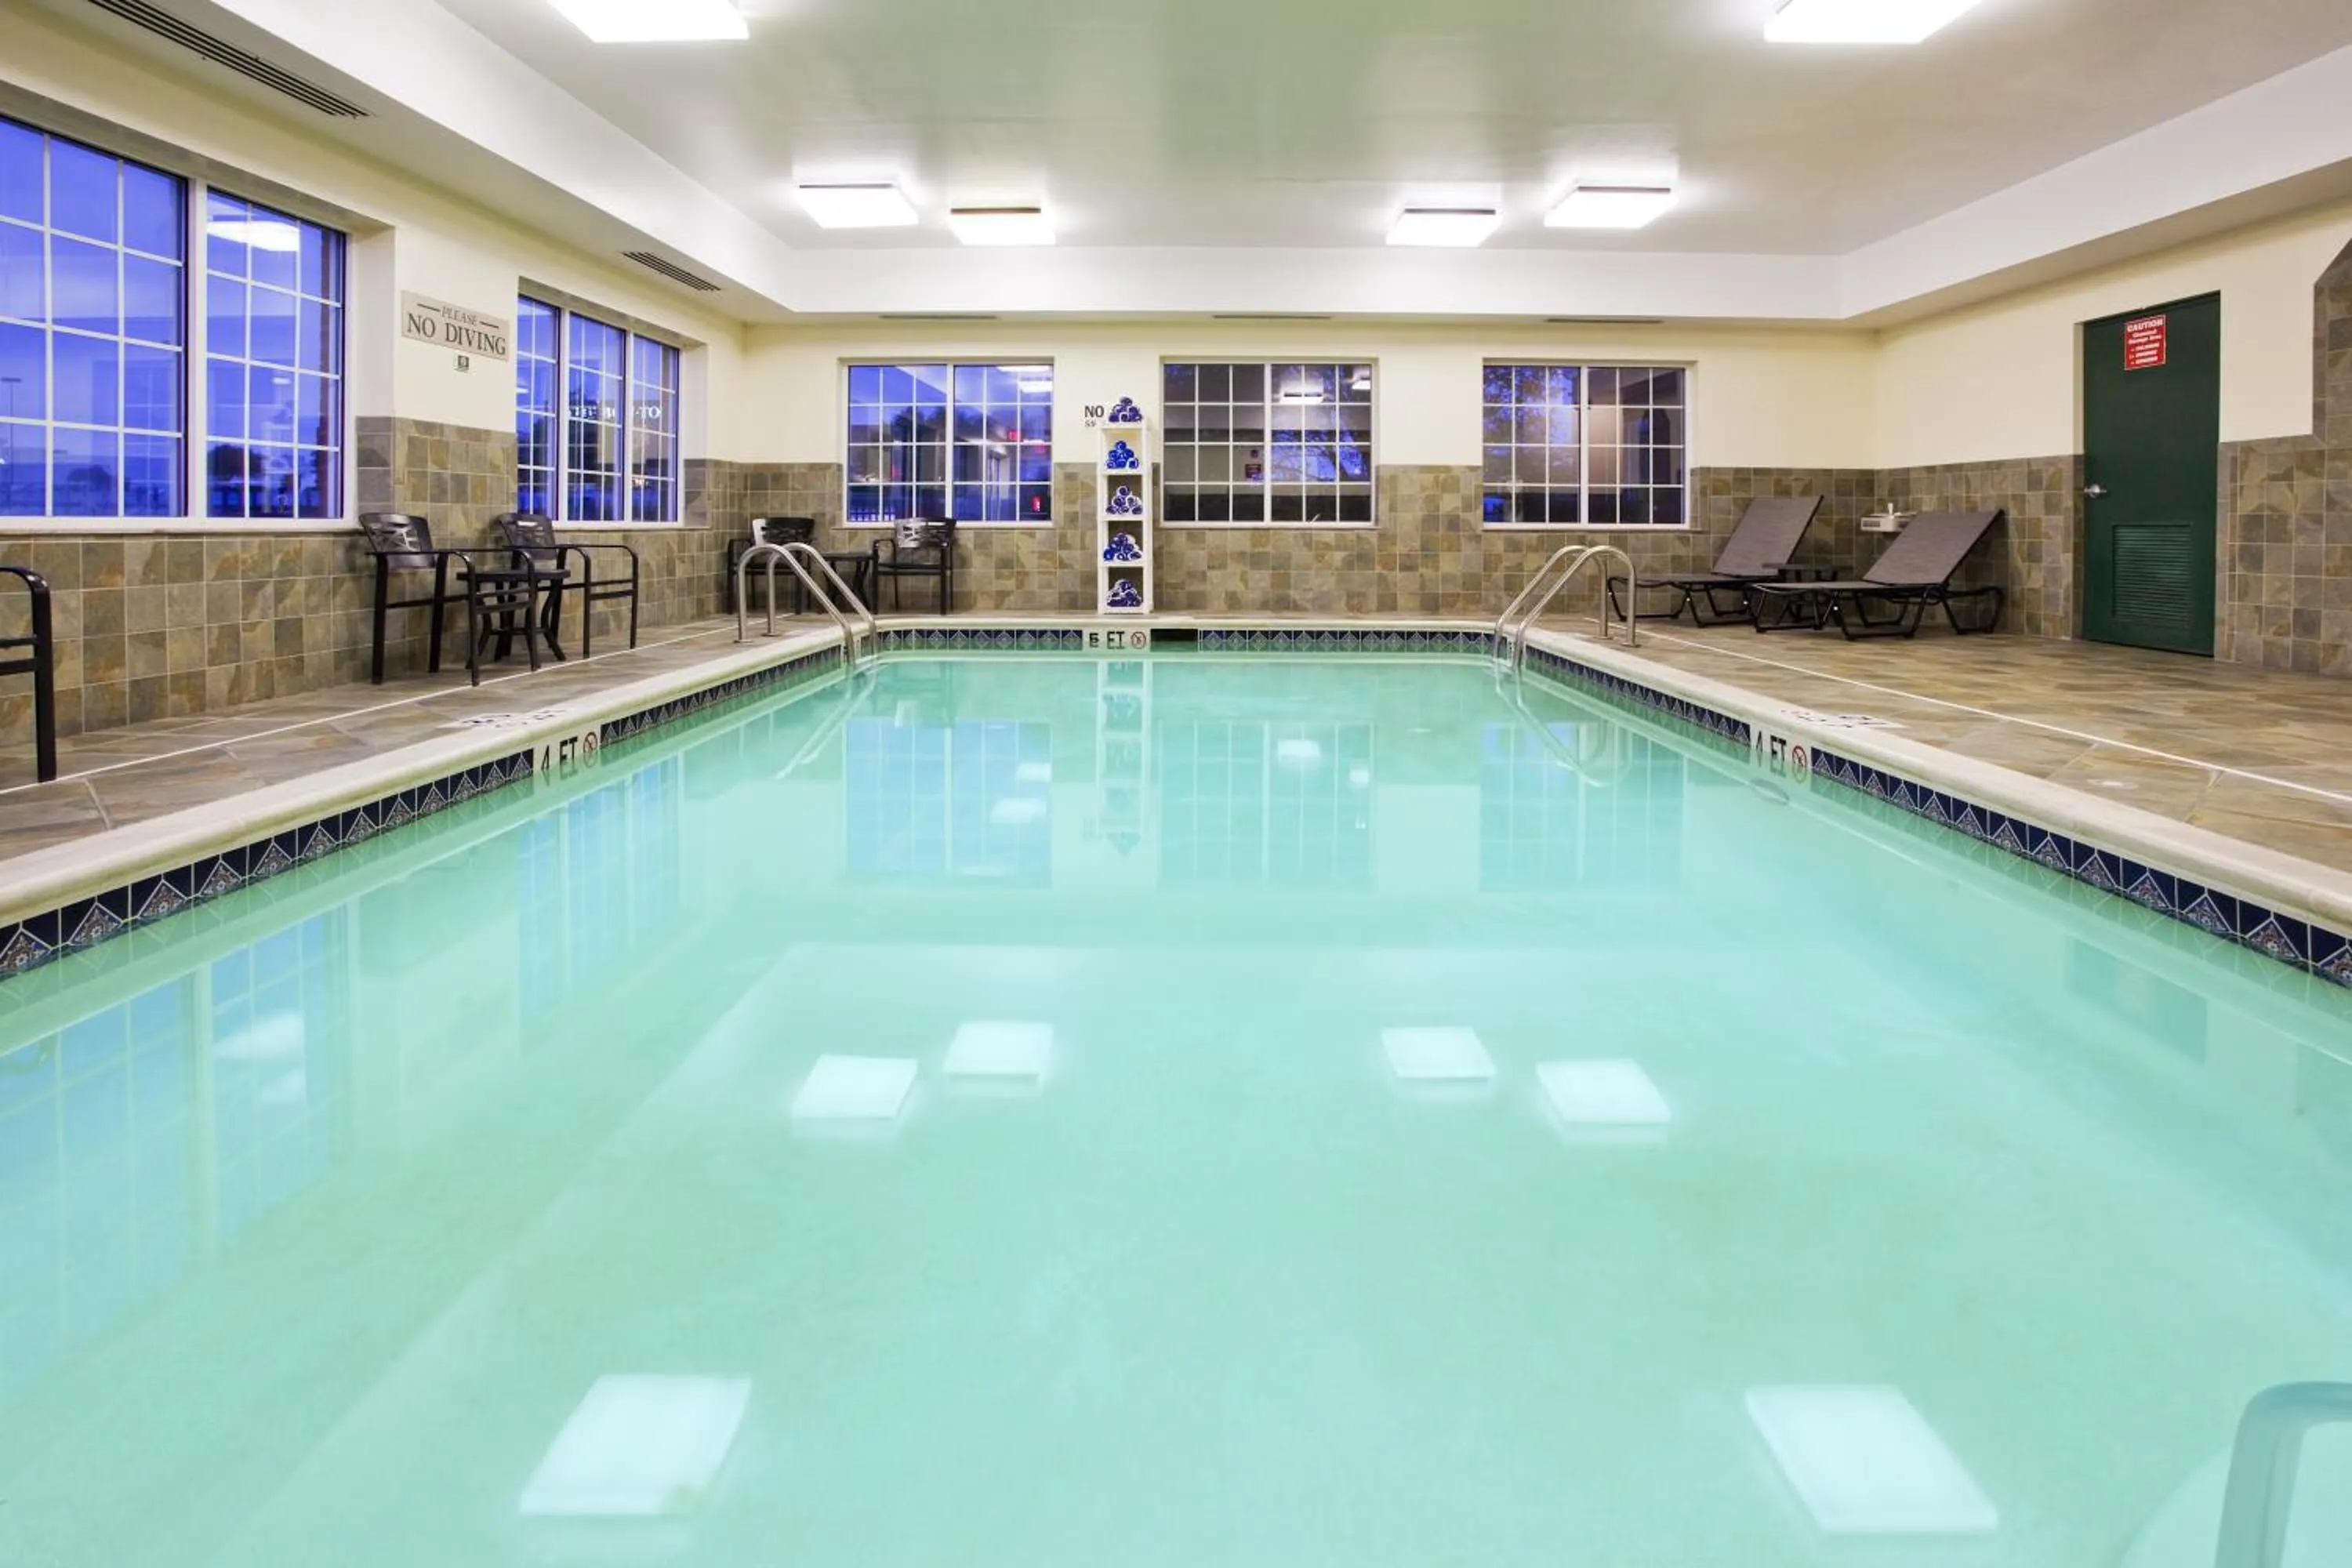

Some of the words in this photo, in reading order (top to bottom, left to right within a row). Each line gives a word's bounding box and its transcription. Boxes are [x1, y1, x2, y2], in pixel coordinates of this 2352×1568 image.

[441, 307, 477, 326] PLEASE
[2127, 319, 2163, 332] CAUTION
[407, 313, 436, 338] NO
[445, 322, 506, 355] DIVING
[1084, 405, 1105, 418] NO
